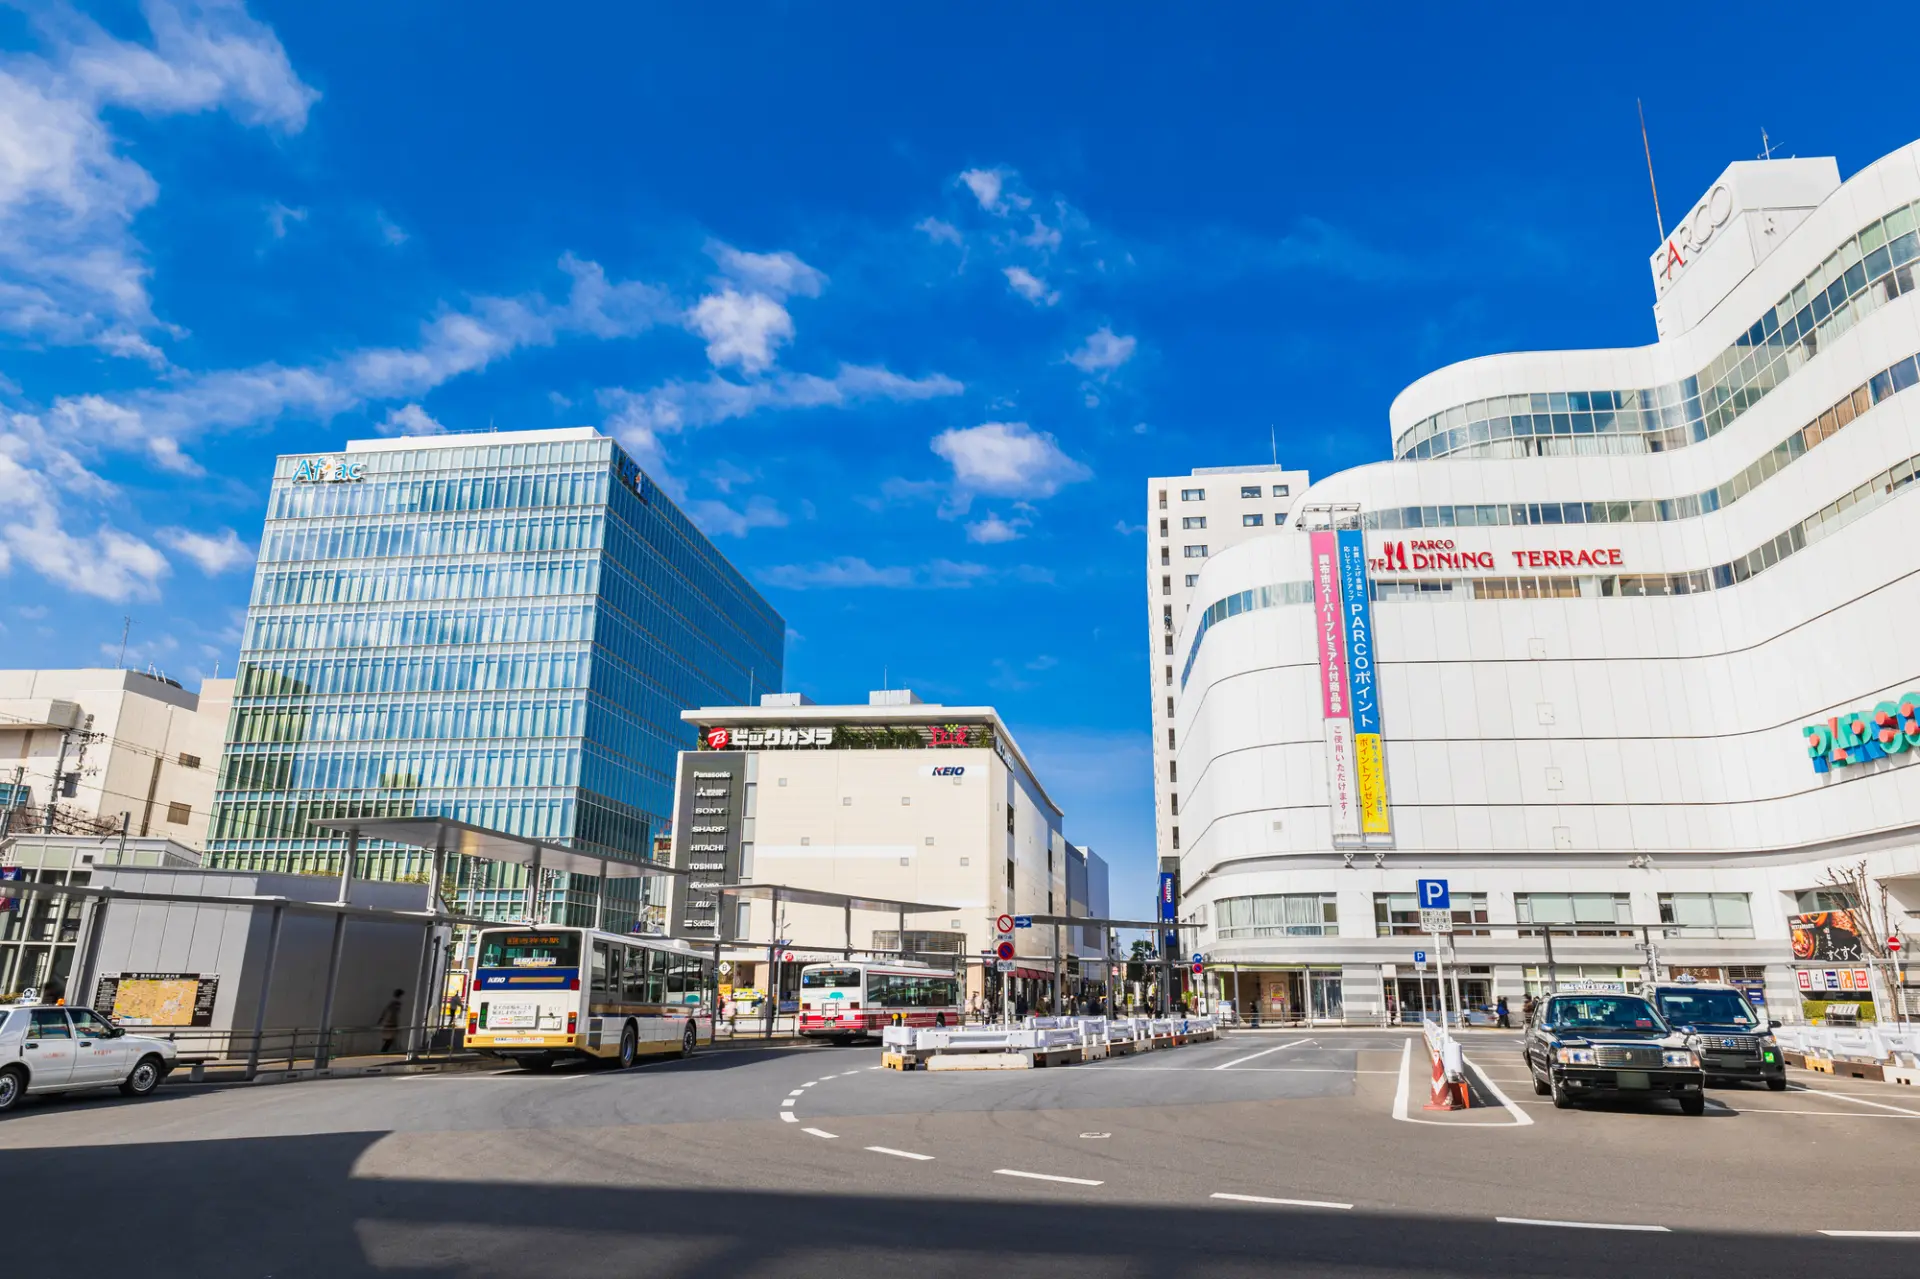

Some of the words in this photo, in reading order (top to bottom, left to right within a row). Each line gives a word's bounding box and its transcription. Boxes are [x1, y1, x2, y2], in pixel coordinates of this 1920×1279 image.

[1655, 183, 1733, 291] PARCO
[1410, 540, 1454, 550] PARCO
[1369, 558, 1384, 571] 7F
[1412, 552, 1494, 570] DINING
[1512, 548, 1623, 568] TERRACE
[1351, 603, 1373, 728] PARCOポイント
[731, 728, 833, 746] ビックカメラ
[932, 766, 965, 776] KEIO
[1360, 738, 1373, 819] ポイントプレゼント
[695, 900, 711, 908] au
[1426, 882, 1444, 906] P
[1417, 952, 1424, 961] P
